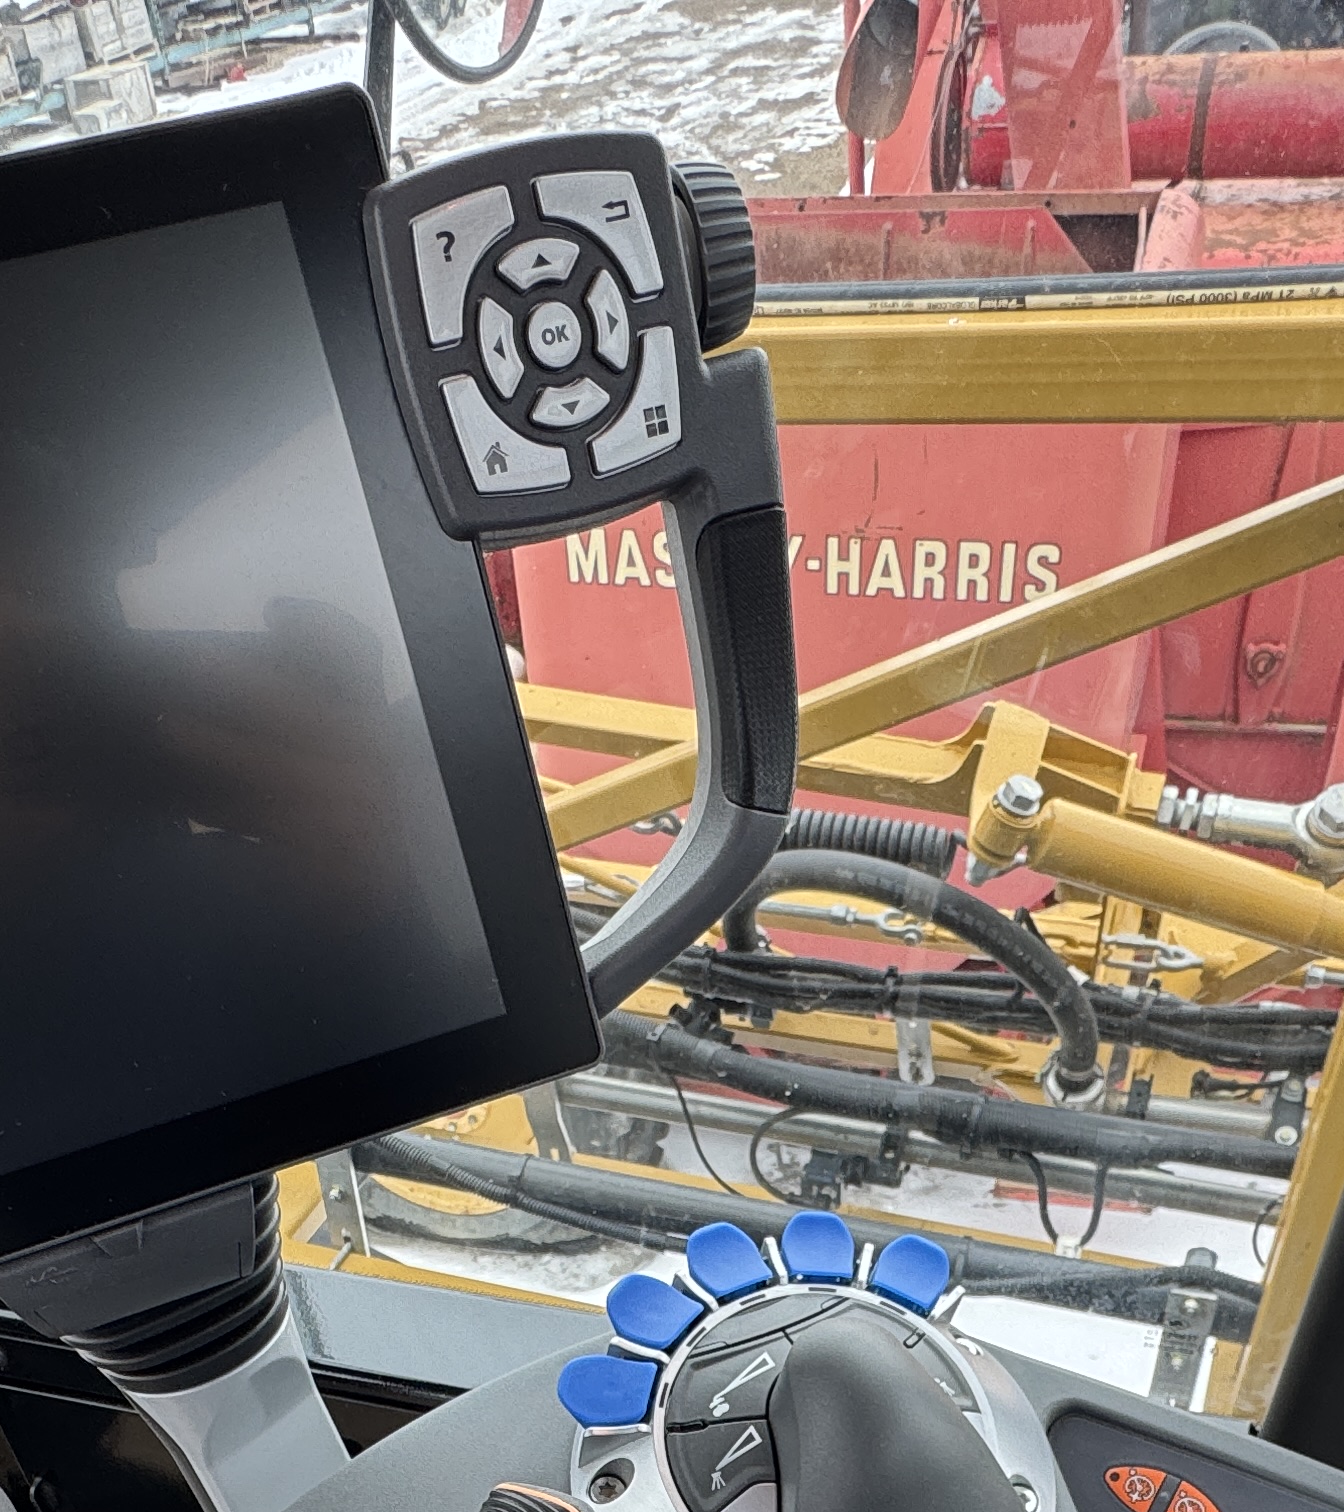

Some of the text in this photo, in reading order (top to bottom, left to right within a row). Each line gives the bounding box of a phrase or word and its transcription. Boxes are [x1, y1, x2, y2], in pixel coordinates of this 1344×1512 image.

[1199, 291, 1237, 304] (3000
[1241, 290, 1273, 302] MPa
[1278, 289, 1295, 300] 21
[541, 324, 570, 346] OK
[565, 527, 1062, 602] MAS-HARRIS
